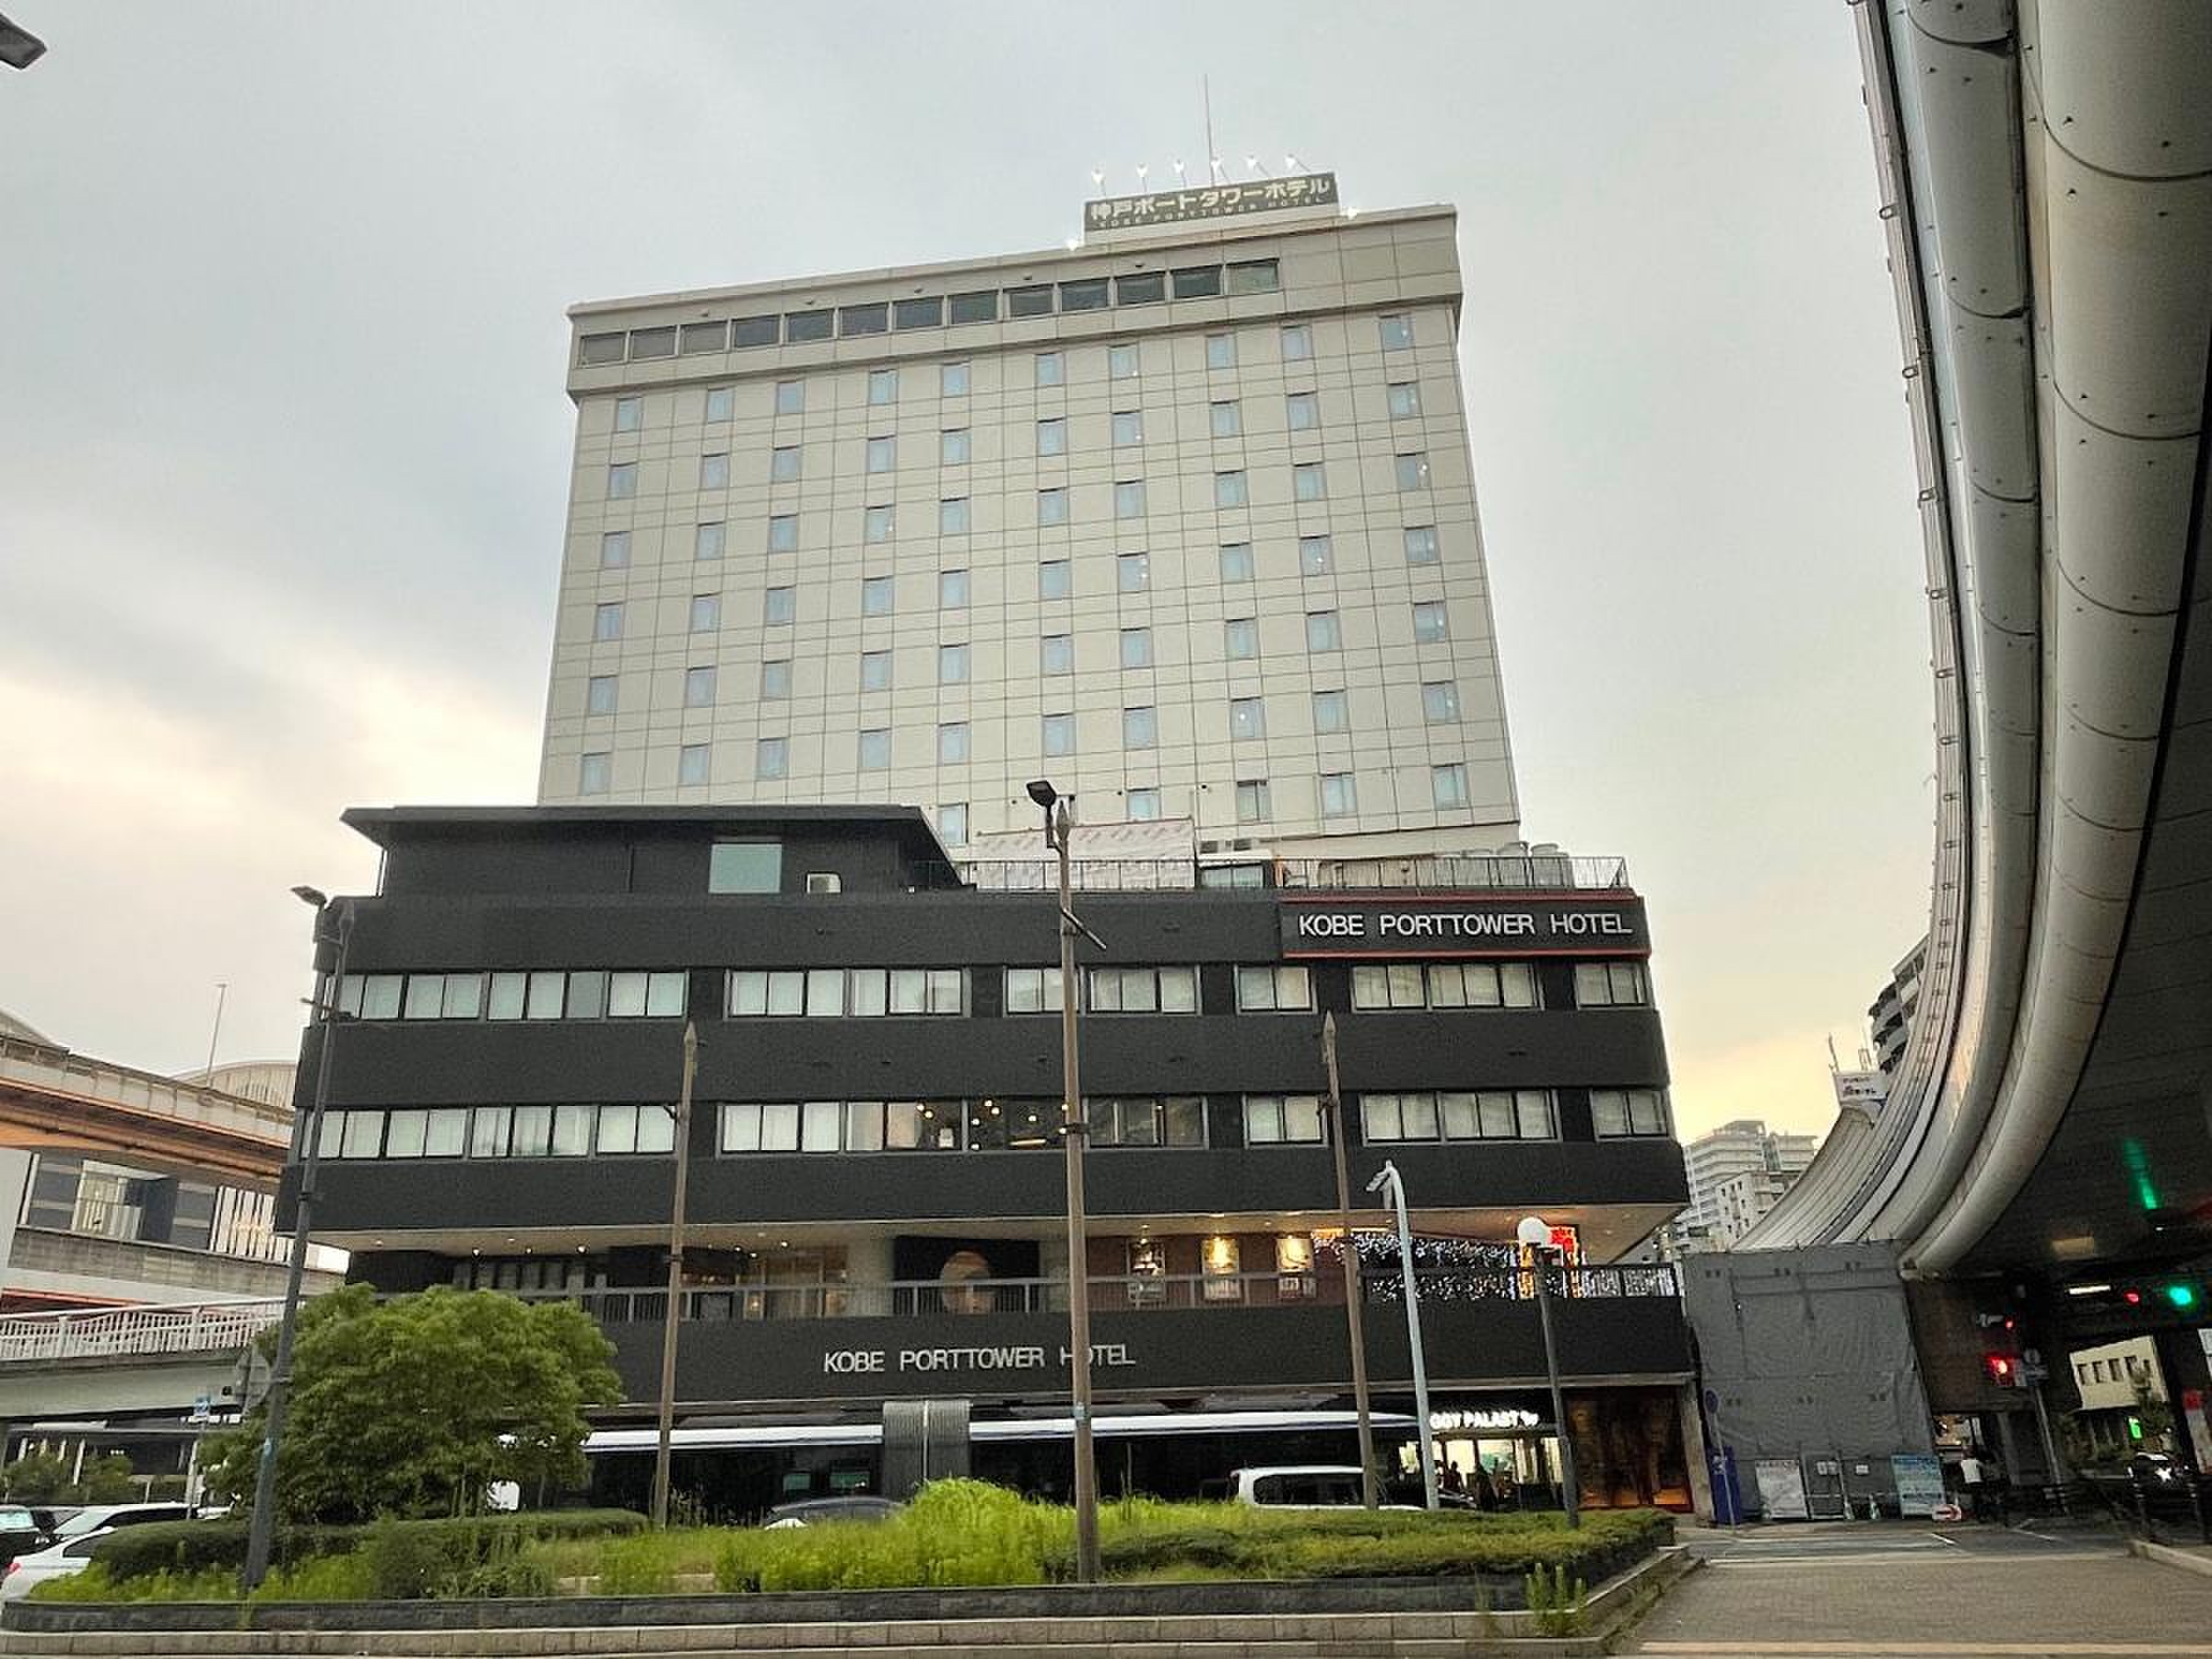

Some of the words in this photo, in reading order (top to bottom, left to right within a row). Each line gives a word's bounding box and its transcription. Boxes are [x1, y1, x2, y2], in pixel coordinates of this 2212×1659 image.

[1091, 179, 1329, 221] 神戸ポートタワーホテル
[1299, 914, 1365, 936] KOBE
[1382, 913, 1536, 935] PORTTOWER
[1550, 913, 1632, 935] HOTEL
[823, 1350, 886, 1372] KOBE
[900, 1347, 1046, 1371] PORTTOWER
[1060, 1344, 1136, 1367] HTEL
